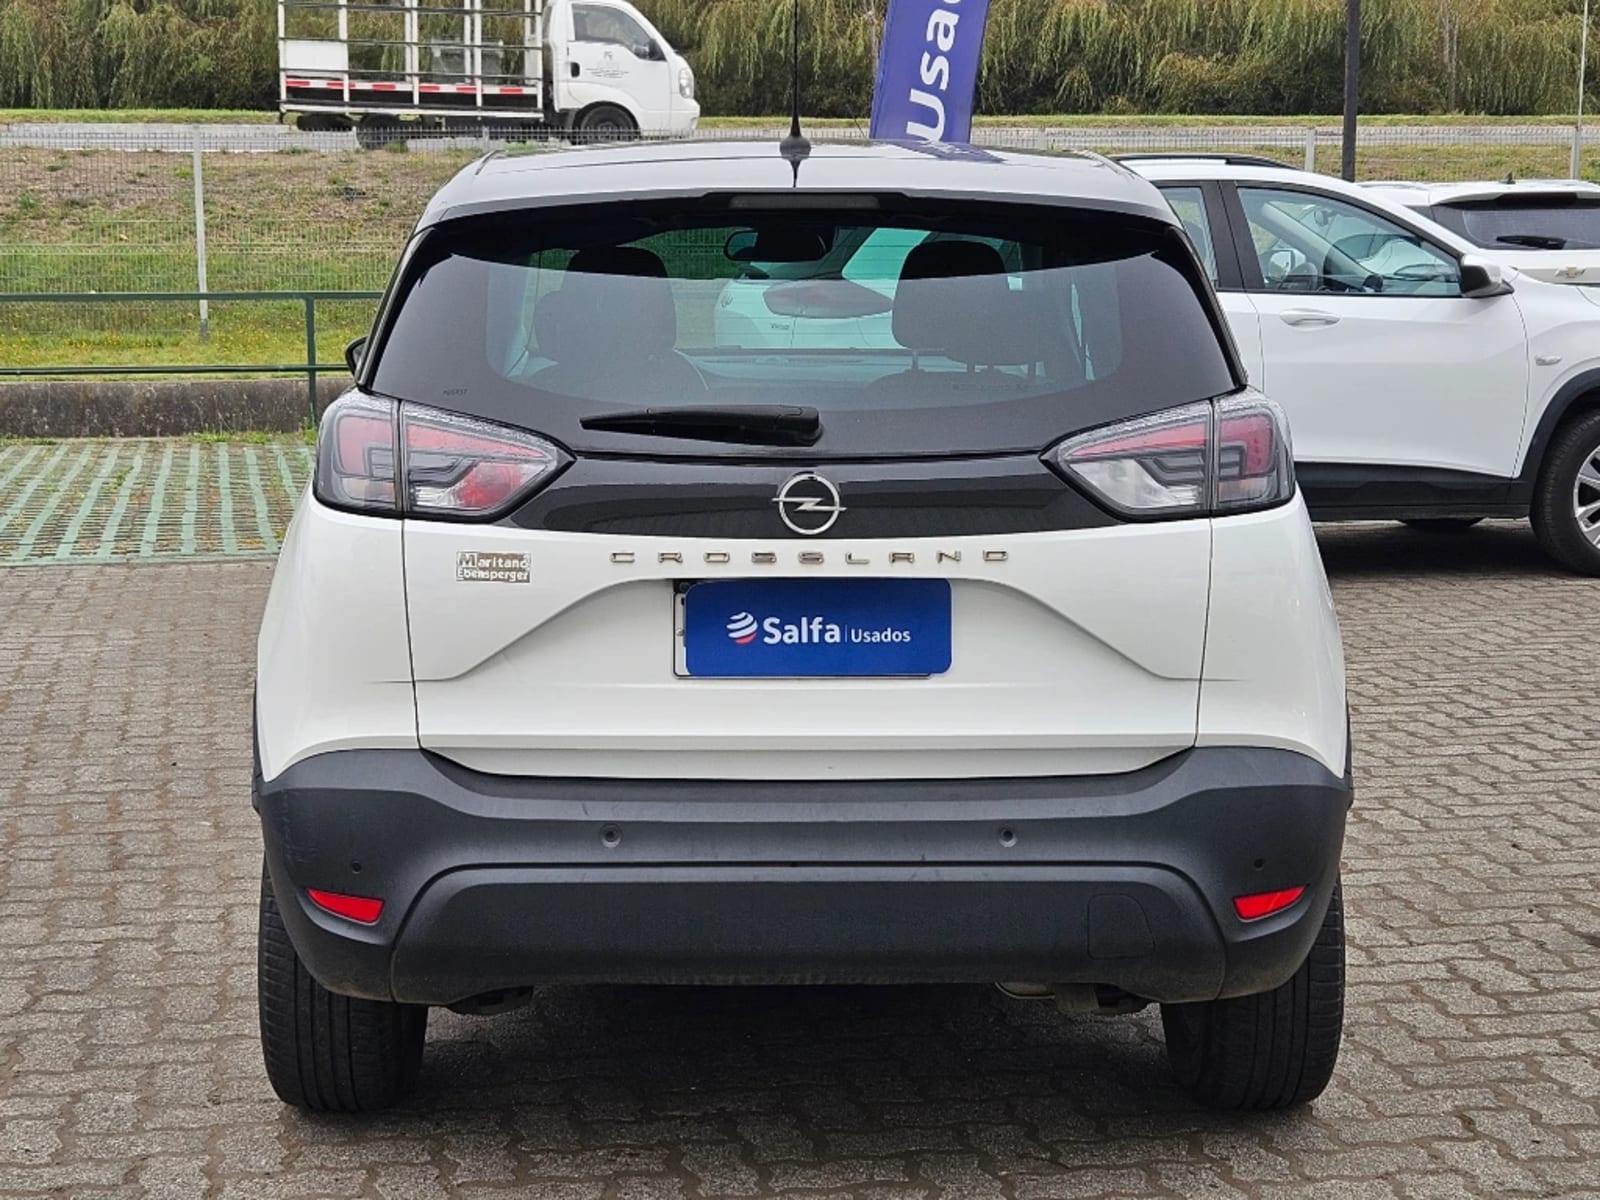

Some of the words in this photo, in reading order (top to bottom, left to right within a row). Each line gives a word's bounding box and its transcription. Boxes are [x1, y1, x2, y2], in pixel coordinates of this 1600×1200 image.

[906, 0, 961, 142] Usa
[610, 551, 1009, 565] CROSSLAND
[762, 616, 842, 645] Salfa
[850, 627, 912, 643] Usados
